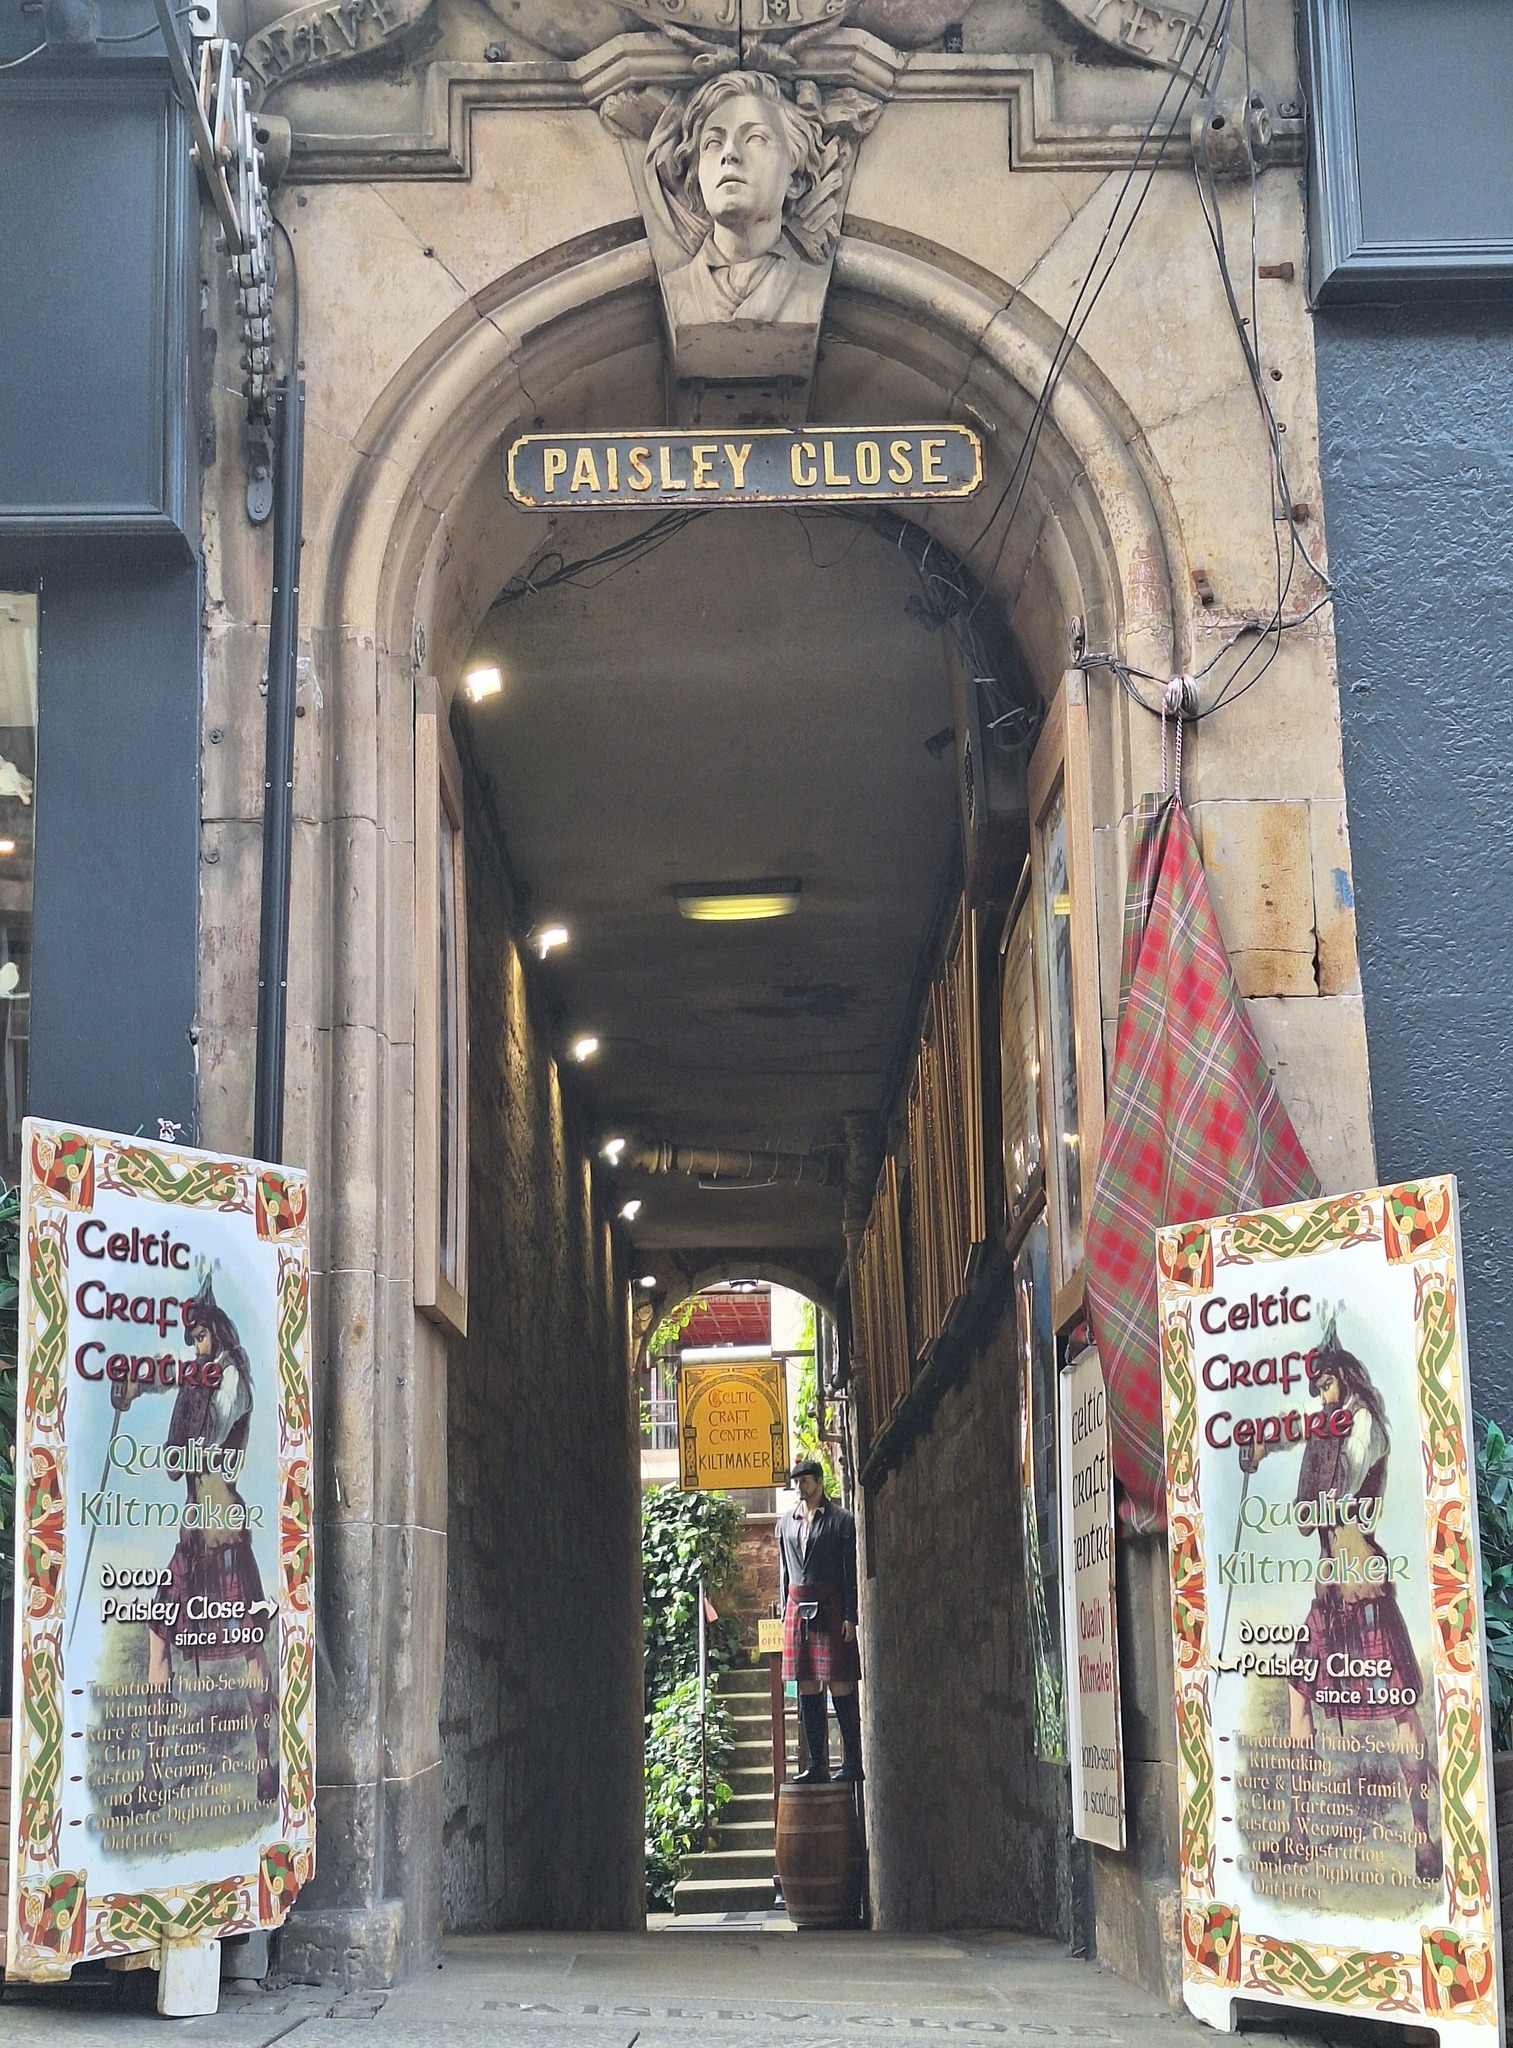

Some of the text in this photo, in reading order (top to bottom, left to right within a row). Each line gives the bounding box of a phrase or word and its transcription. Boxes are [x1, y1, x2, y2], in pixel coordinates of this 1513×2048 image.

[543, 438, 949, 494] PAISLEY CLOSE
[75, 1219, 191, 1271] Celtic
[75, 1280, 198, 1337] Craft
[1199, 1286, 1312, 1335] Celtic
[75, 1341, 223, 1390] Centre
[1202, 1347, 1321, 1395] Craft
[1204, 1407, 1353, 1450] Centre
[108, 1433, 246, 1483] Quality
[699, 1451, 770, 1471] KILTMAKER
[80, 1489, 266, 1530] Kiltmaker
[1239, 1489, 1384, 1534] Quality
[100, 1562, 173, 1588] down
[1216, 1548, 1414, 1587] Kiltmaker
[100, 1595, 245, 1626] Paisley Close
[1080, 1597, 1105, 1644] Quality
[174, 1627, 264, 1646] since 1980
[1239, 1619, 1310, 1643] down
[1079, 1653, 1112, 1693] Kiltmaker
[1241, 1651, 1393, 1682] Paisley Close
[105, 1699, 187, 1719] Kiltmaking
[1315, 1686, 1416, 1705] since 1980
[131, 1723, 140, 1739] &
[148, 1717, 204, 1738] Unusual
[210, 1714, 258, 1734] Family
[263, 1713, 271, 1729] &
[105, 1741, 206, 1763] Clan Tartans
[1250, 1751, 1332, 1777] Kiltmaking
[104, 1781, 231, 1807] and Registration
[1251, 1793, 1354, 1815] Clan Tartans
[1275, 1775, 1285, 1791] &
[1292, 1775, 1352, 1795] Unusual
[1358, 1778, 1412, 1803] Family
[1420, 1783, 1430, 1800] &
[1252, 1837, 1385, 1863] and Registration
[481, 2001, 1111, 2037] PAISLEY CLOSE
